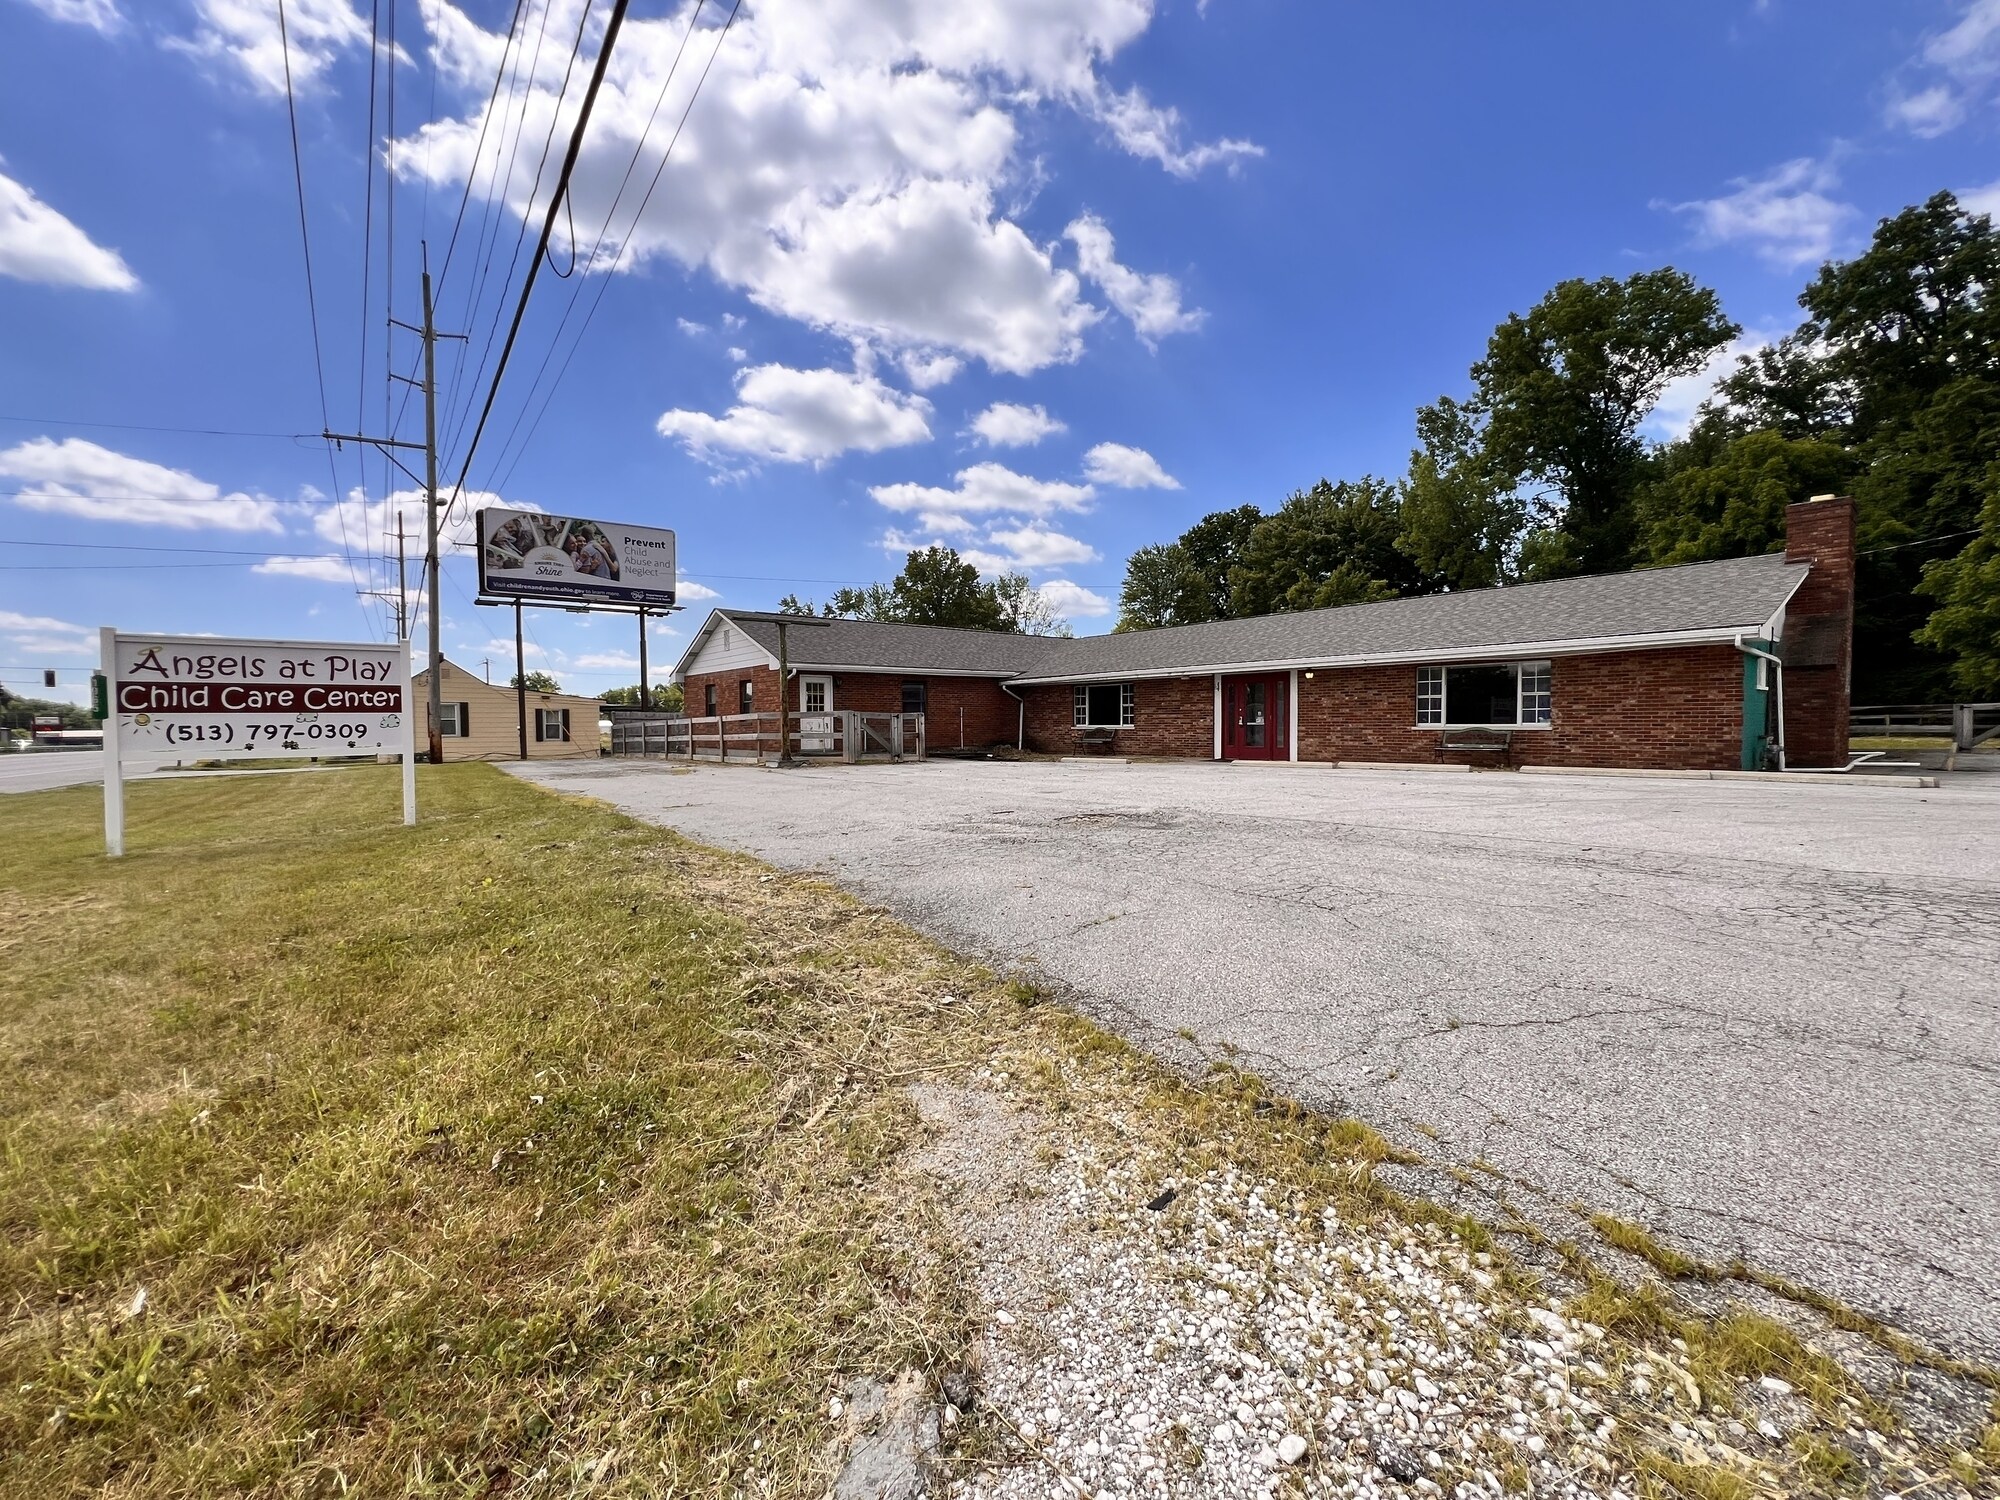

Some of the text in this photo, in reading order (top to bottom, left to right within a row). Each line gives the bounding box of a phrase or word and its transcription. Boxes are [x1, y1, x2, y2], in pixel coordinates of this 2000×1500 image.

[624, 536, 666, 549] Prevent
[624, 546, 647, 556] Child
[624, 556, 671, 568] Abuse and
[535, 565, 563, 576] Shine
[624, 566, 659, 577] Neglect
[506, 582, 585, 594] childrenandyouth.ohio.gov
[129, 648, 392, 682] Angels at Play
[119, 685, 209, 711] Child
[221, 686, 294, 710] Care
[303, 687, 400, 710] Center
[166, 723, 368, 744] (513) 797-0309
